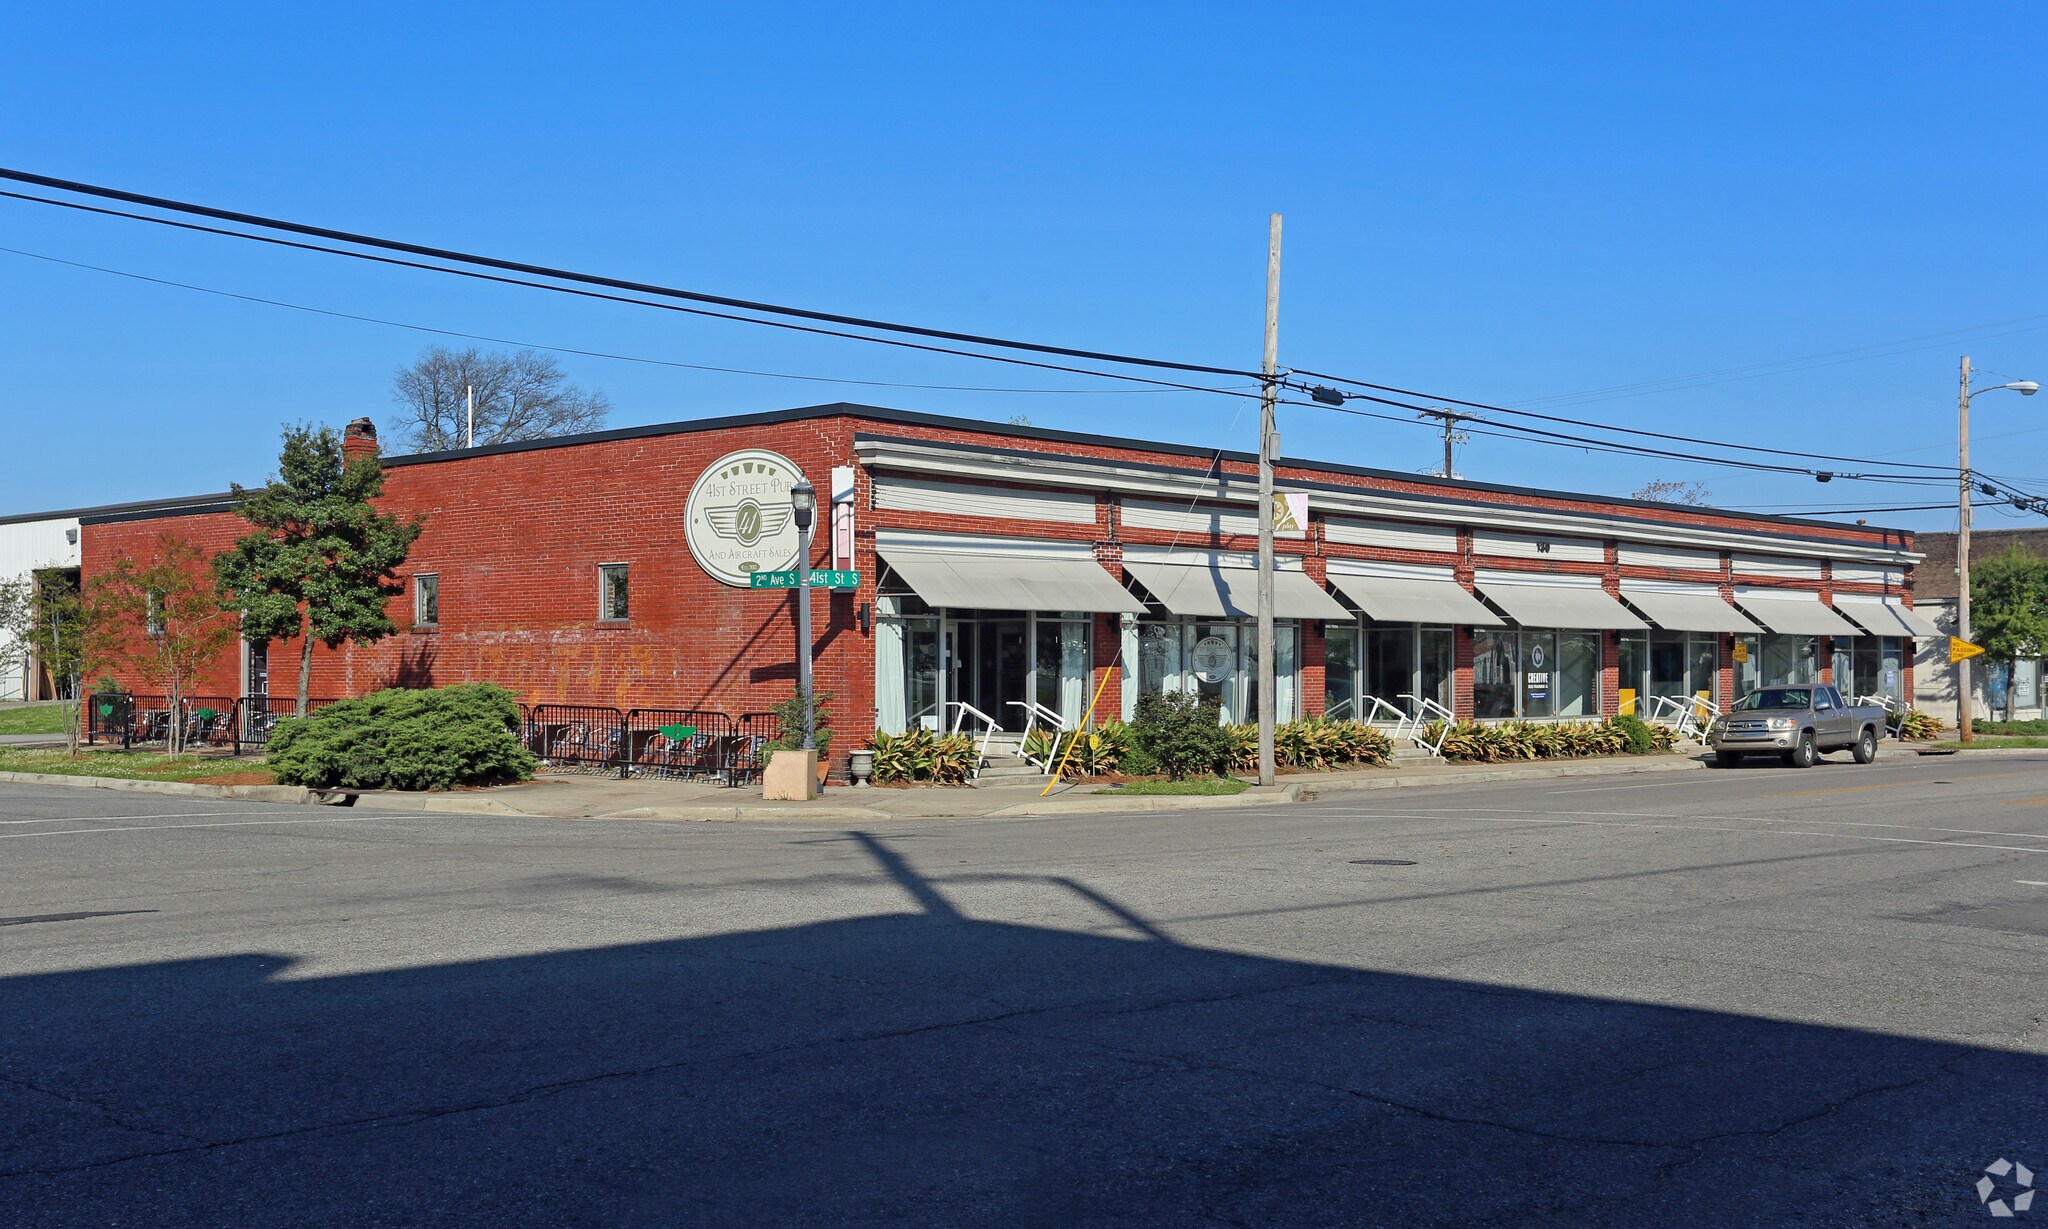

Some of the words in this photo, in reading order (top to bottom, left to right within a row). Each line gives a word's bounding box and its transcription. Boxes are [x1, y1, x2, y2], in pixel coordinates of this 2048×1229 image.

[729, 481, 768, 496] STREET
[738, 511, 758, 534] 41
[709, 549, 726, 560] AND
[728, 548, 767, 559] AIRCRAFT
[769, 546, 791, 558] SALES
[770, 574, 784, 585] Ave
[789, 573, 795, 585] S
[809, 572, 828, 584] 41st
[835, 572, 845, 585] St
[852, 573, 858, 585] S
[1527, 672, 1549, 683] CREATIVE
